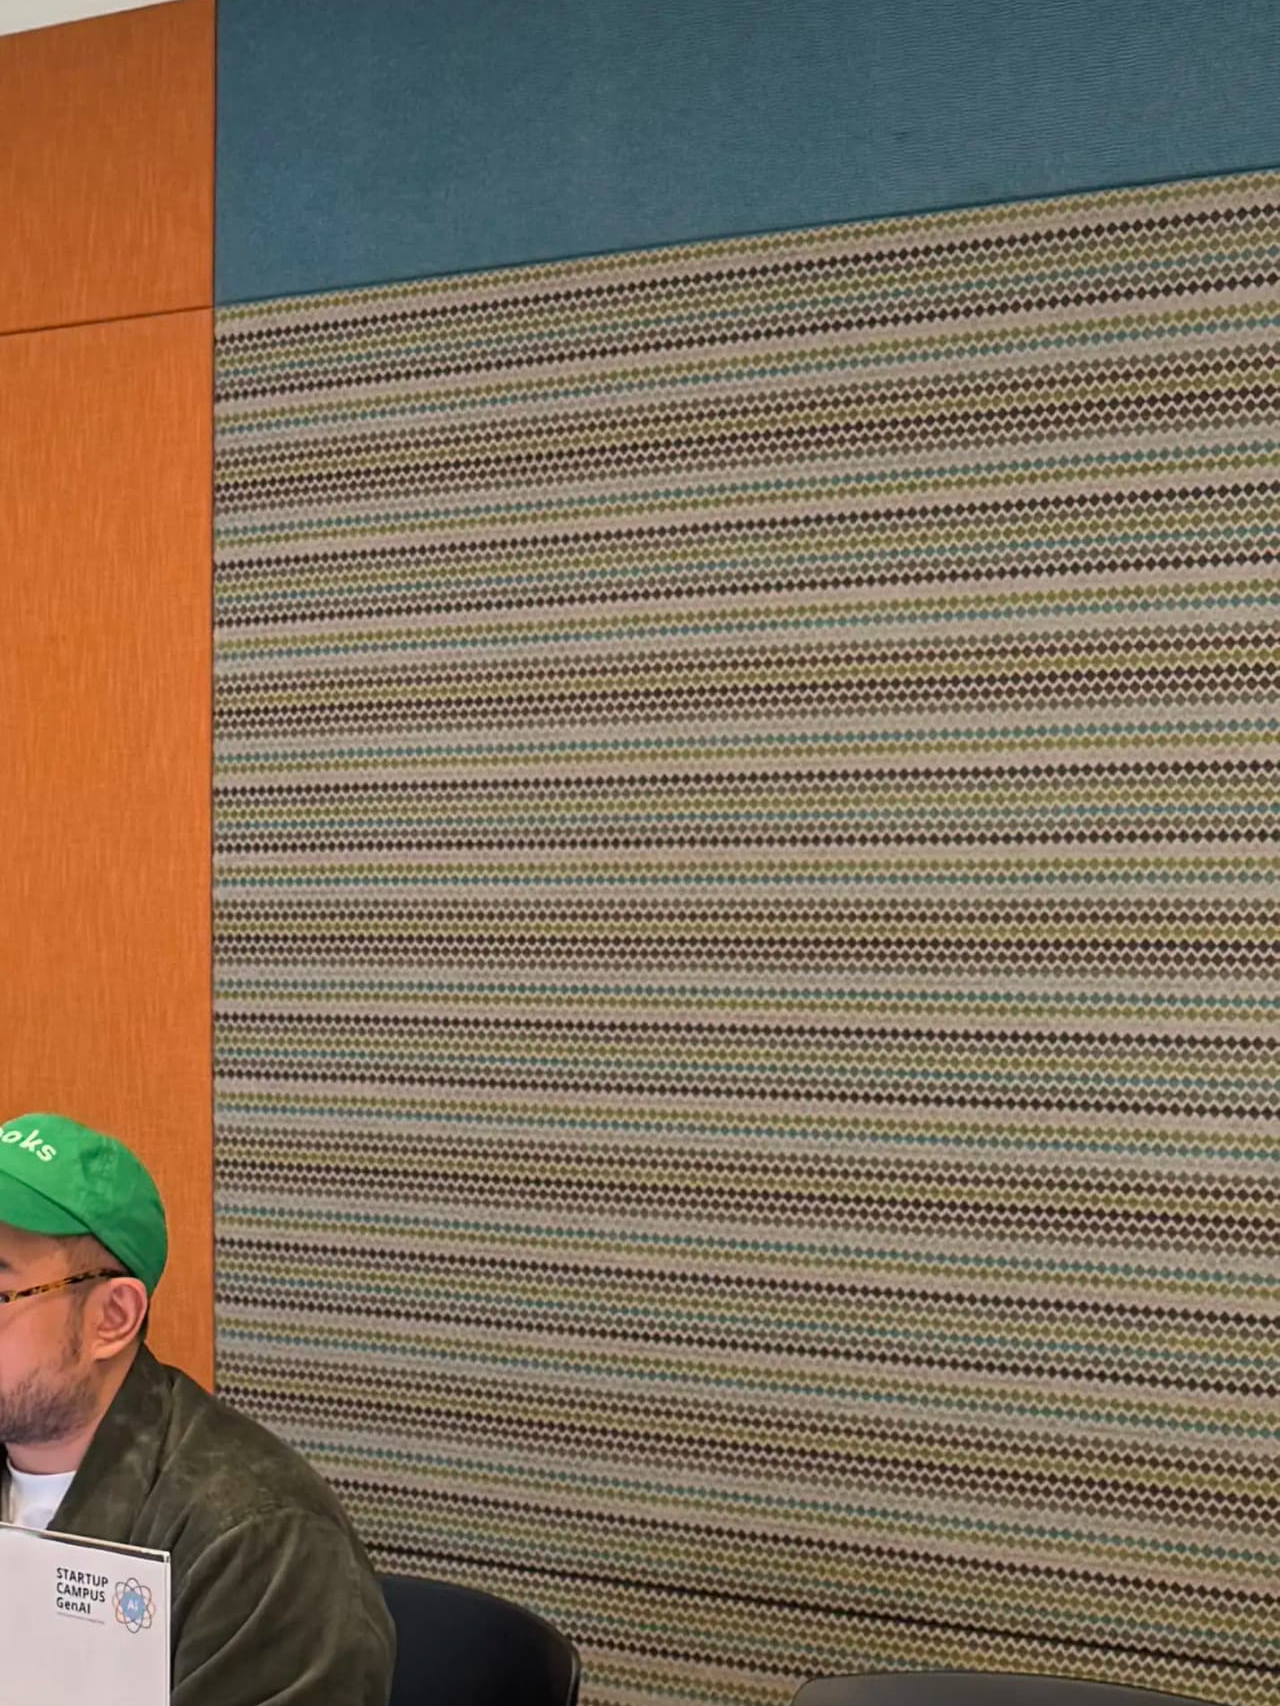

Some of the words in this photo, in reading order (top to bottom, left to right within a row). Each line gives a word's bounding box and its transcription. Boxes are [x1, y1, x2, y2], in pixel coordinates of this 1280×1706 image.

[56, 1567, 108, 1587] STARTUP
[56, 1582, 105, 1603] CAMPUS
[56, 1597, 90, 1613] GenAI
